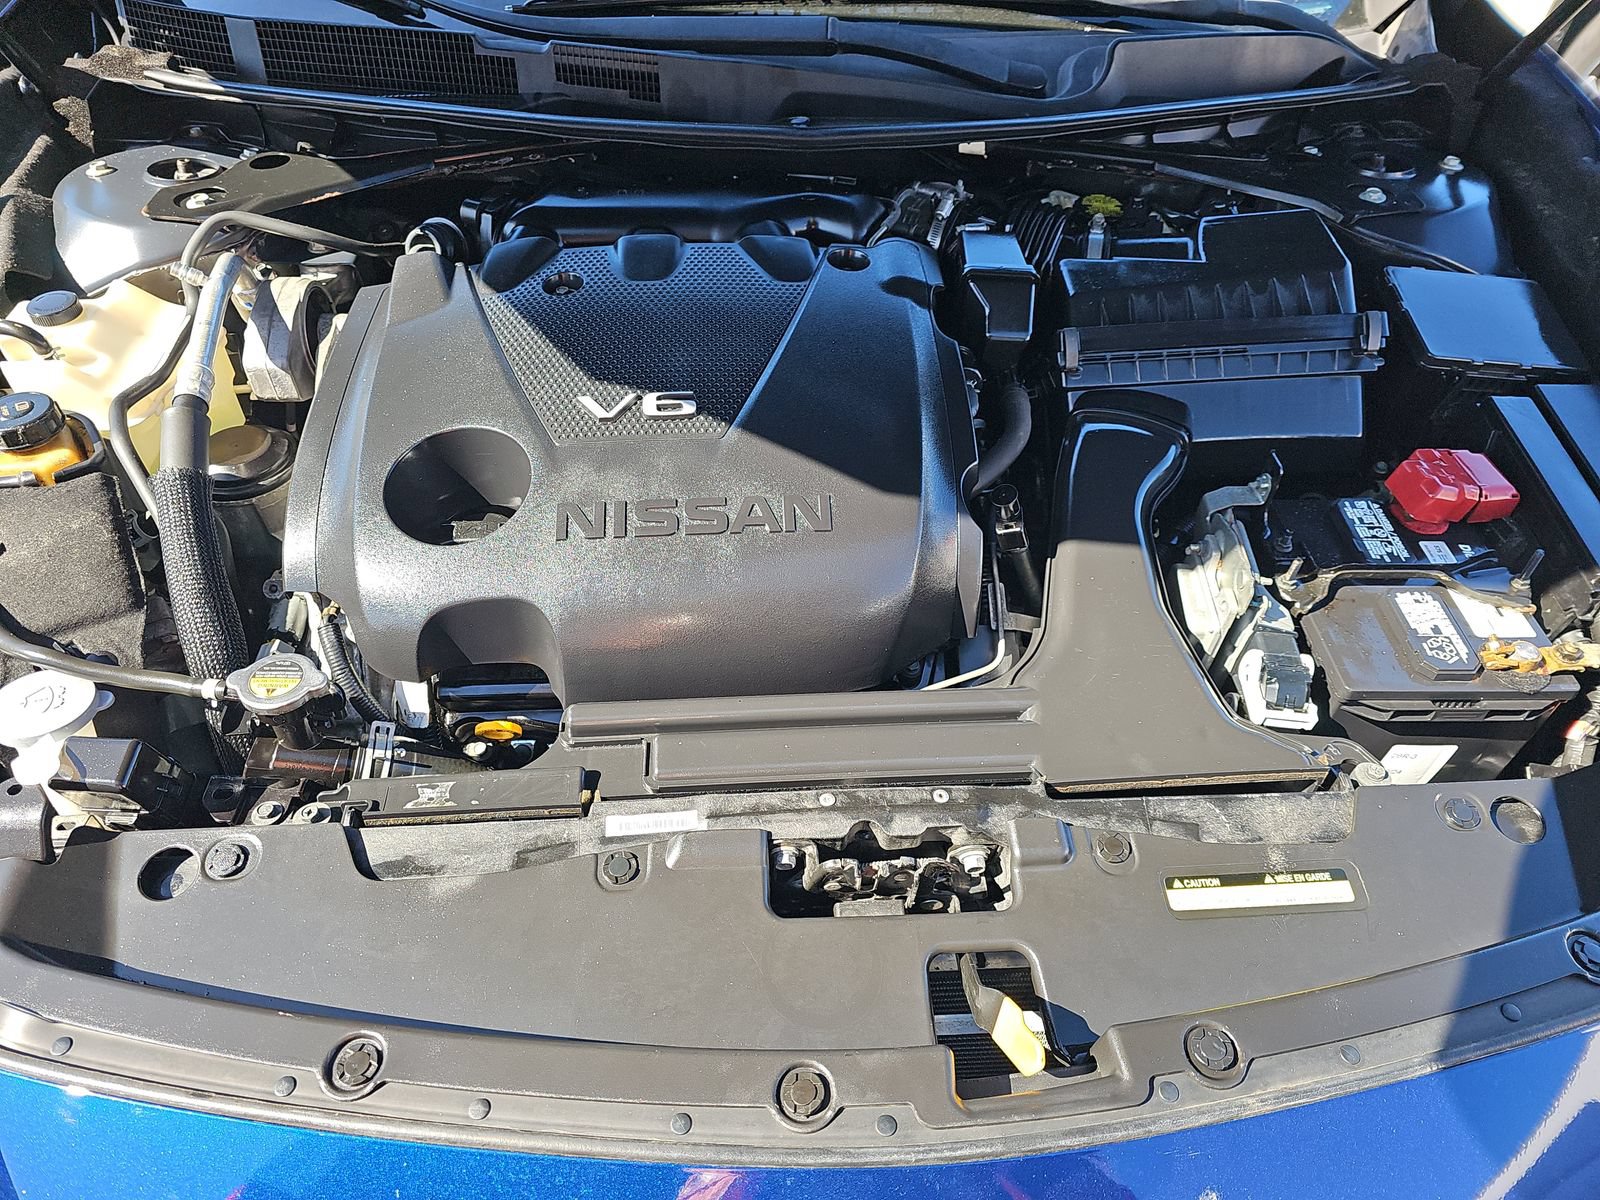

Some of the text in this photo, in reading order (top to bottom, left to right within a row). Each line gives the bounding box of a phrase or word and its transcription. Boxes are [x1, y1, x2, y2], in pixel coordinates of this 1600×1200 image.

[576, 391, 697, 422] V6
[556, 494, 832, 541] NISSAN
[1184, 878, 1220, 888] CAUTION
[1295, 873, 1305, 882] EN
[1305, 872, 1332, 882] GARDE
